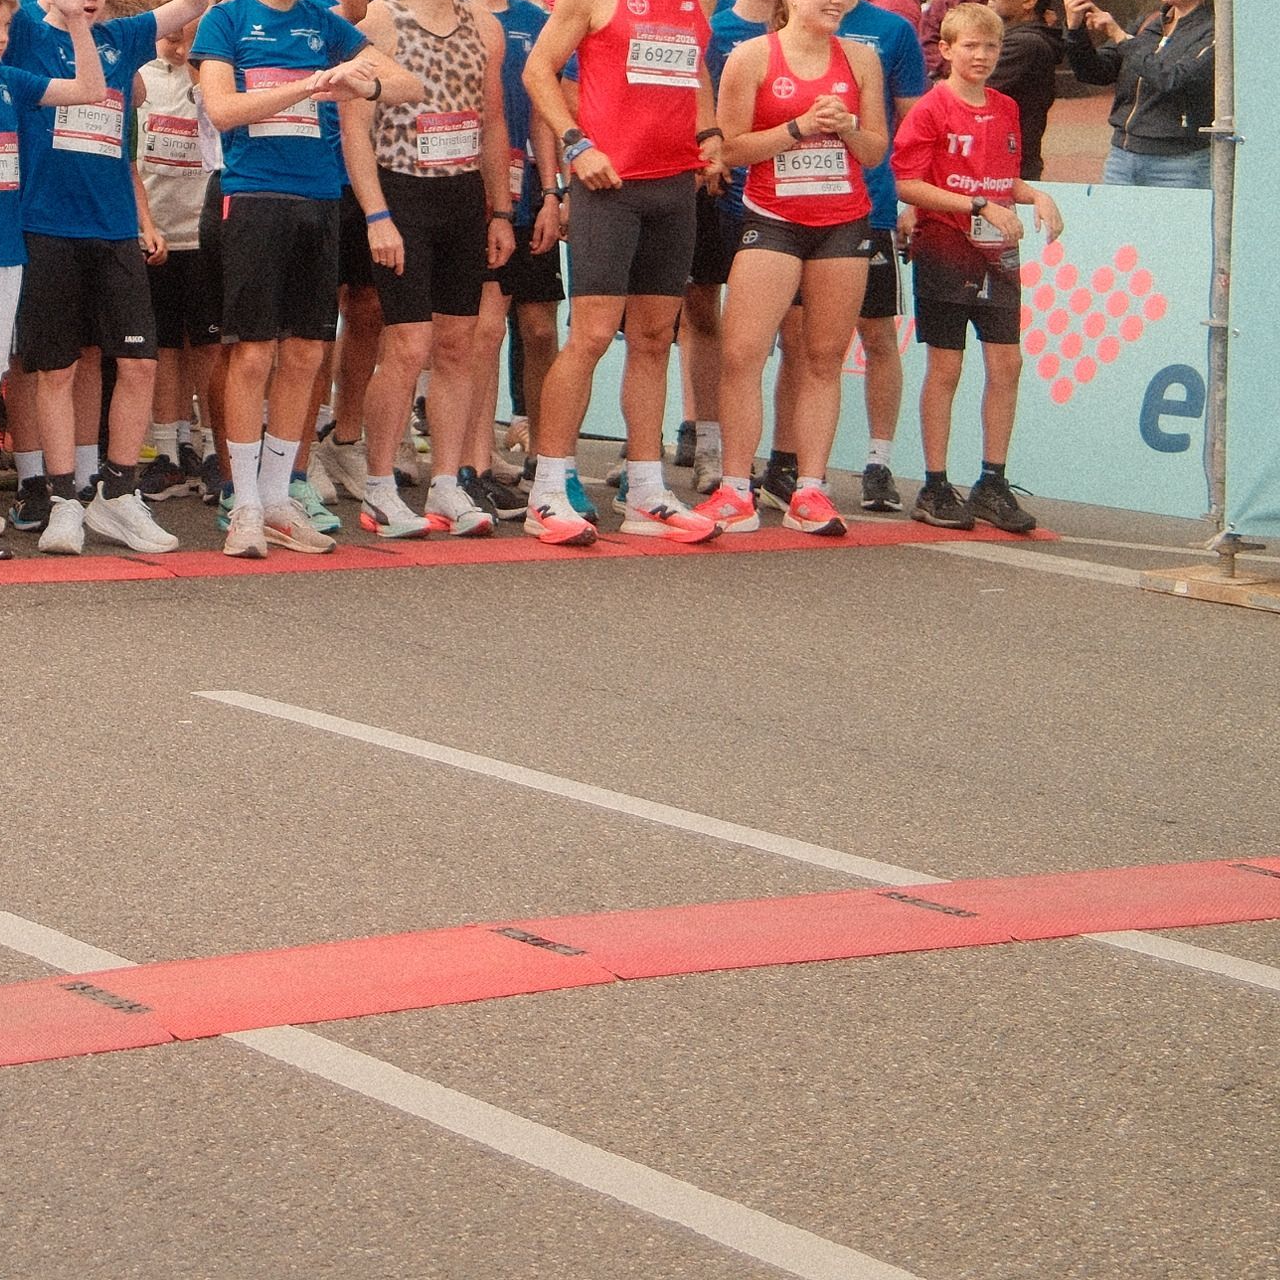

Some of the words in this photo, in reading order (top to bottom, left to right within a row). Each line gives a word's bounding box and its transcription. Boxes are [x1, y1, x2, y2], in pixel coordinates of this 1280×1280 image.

[644, 48, 684, 64] 6927
[77, 107, 111, 123] Henry
[161, 137, 197, 151] Simon
[430, 135, 472, 147] Christian
[947, 132, 974, 157] 17
[791, 154, 833, 170] 6926
